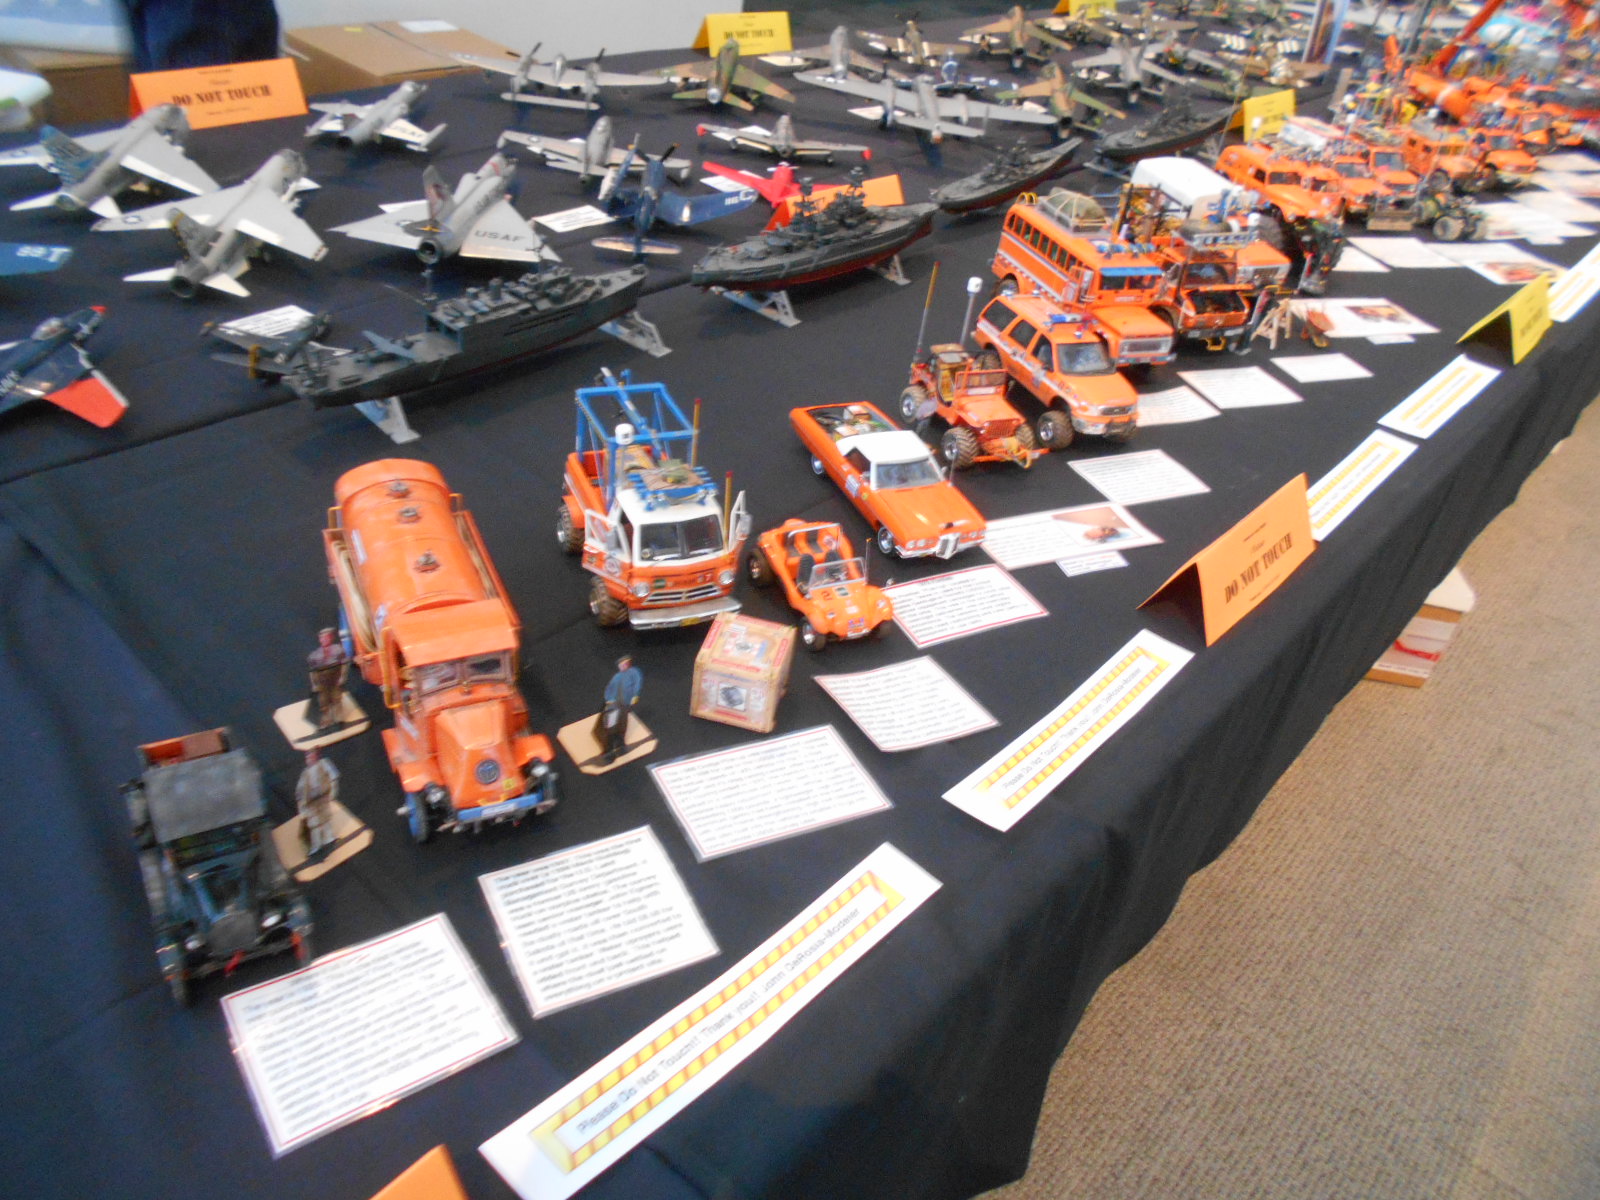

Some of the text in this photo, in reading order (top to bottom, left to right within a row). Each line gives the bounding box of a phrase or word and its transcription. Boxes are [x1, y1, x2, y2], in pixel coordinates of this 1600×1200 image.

[172, 84, 271, 106] DO NOT TOUCH
[474, 229, 526, 243] USAF
[1224, 578, 1239, 605] DO
[1239, 559, 1261, 588] NOT
[1262, 531, 1294, 570] TOUCH
[576, 1101, 619, 1134] Please
[637, 1068, 660, 1087] Not
[700, 1011, 733, 1037] Thank
